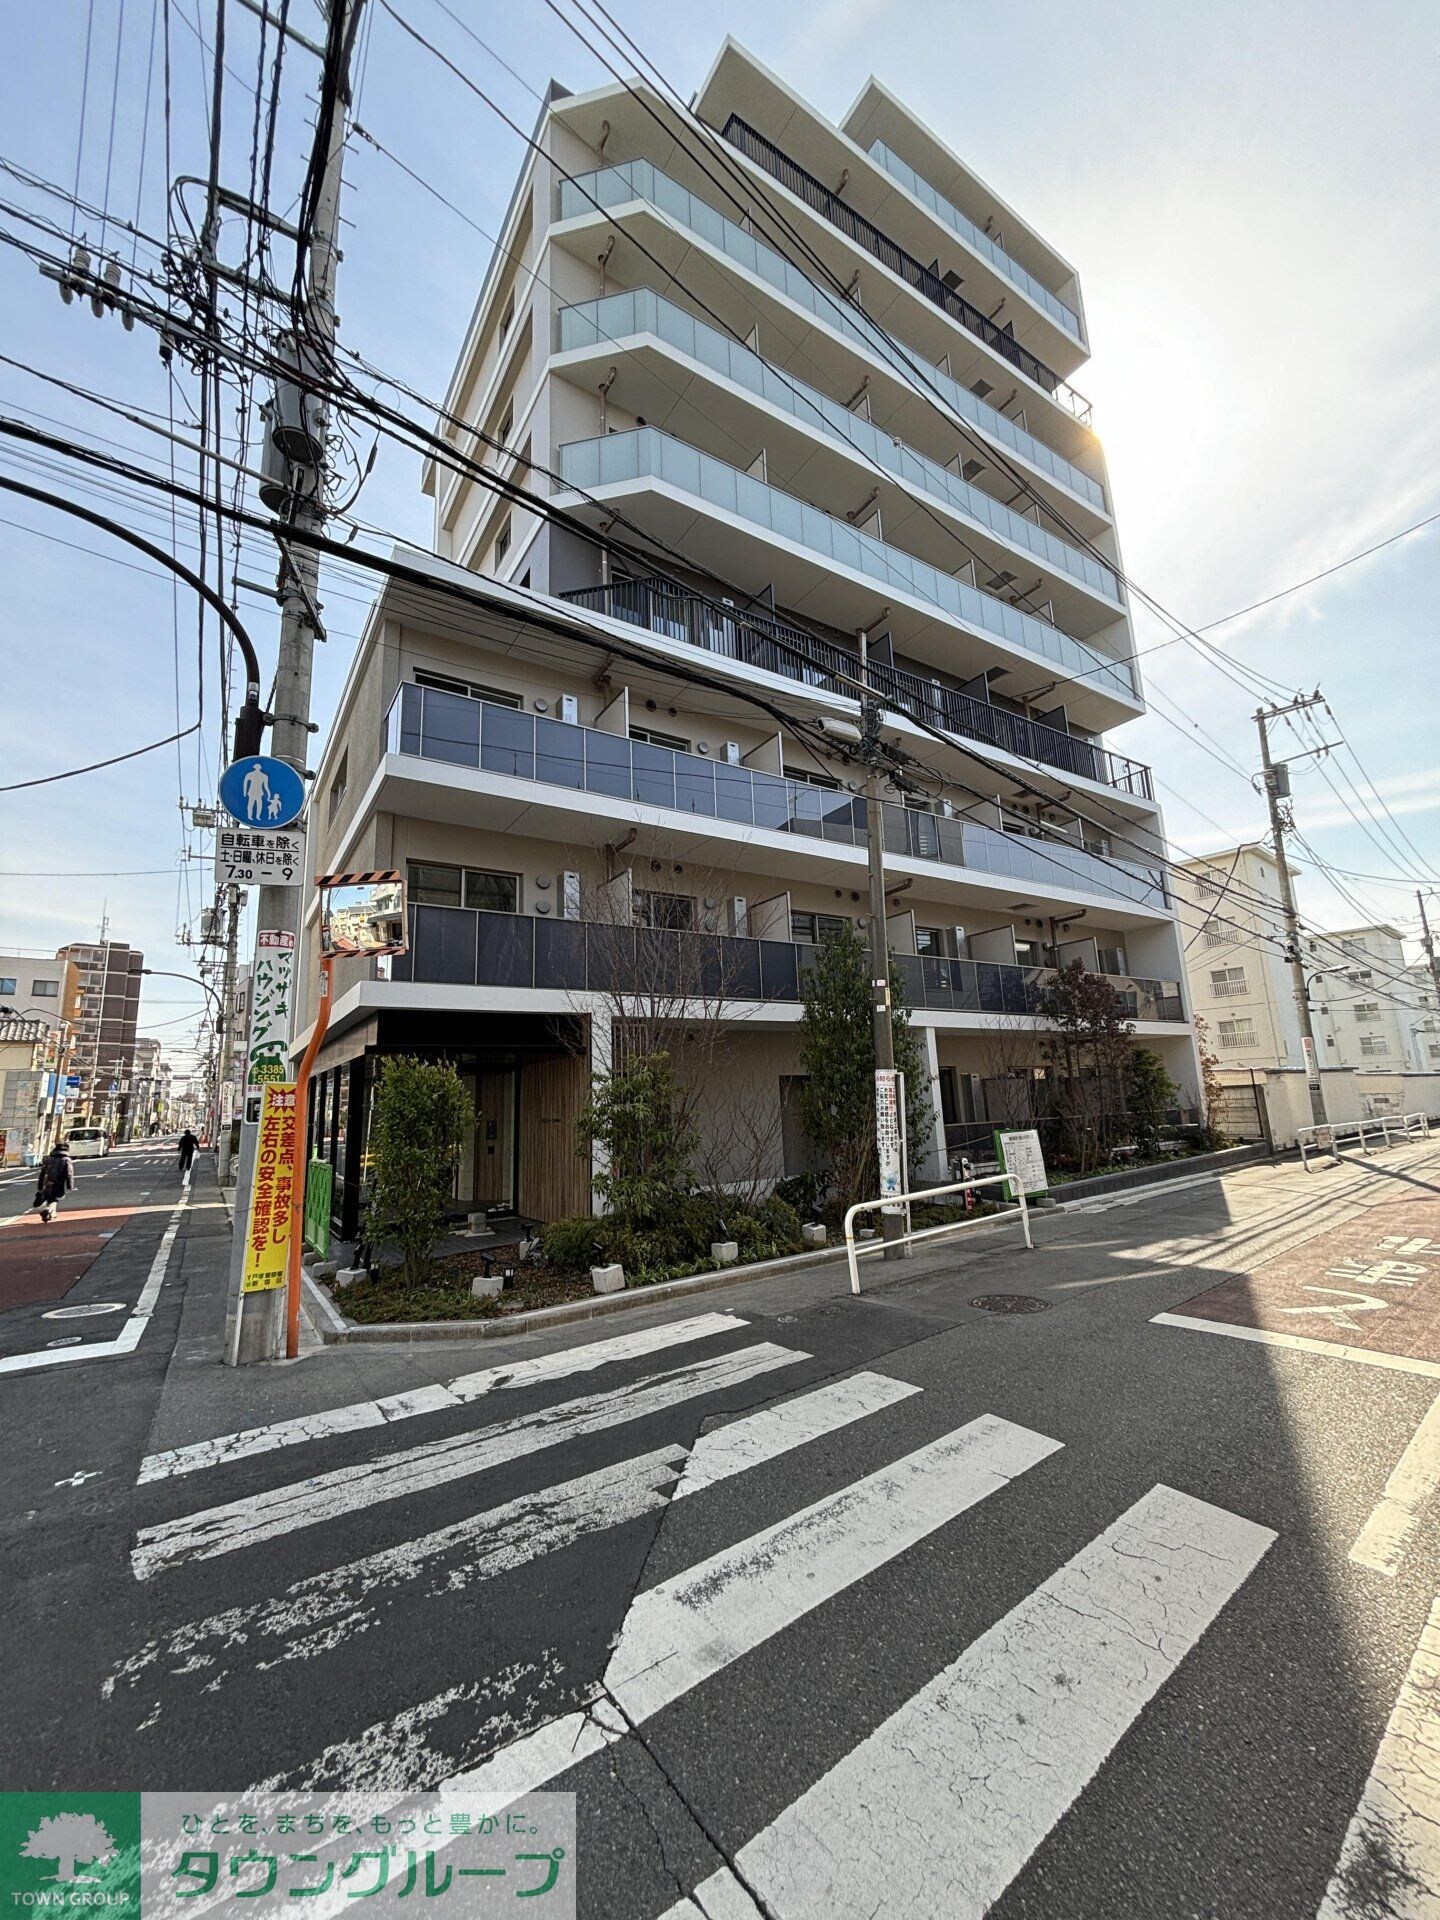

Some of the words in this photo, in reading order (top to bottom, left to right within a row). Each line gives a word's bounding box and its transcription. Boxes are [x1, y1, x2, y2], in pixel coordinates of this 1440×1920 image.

[221, 833, 300, 850] 自転車を除く
[225, 864, 253, 880] 7.30
[282, 867, 294, 881] 9
[252, 959, 275, 1042] ハウジング
[274, 951, 293, 1020] マツザキ
[272, 1094, 296, 1108] 注意
[271, 1115, 296, 1244] 交差点、事故多し
